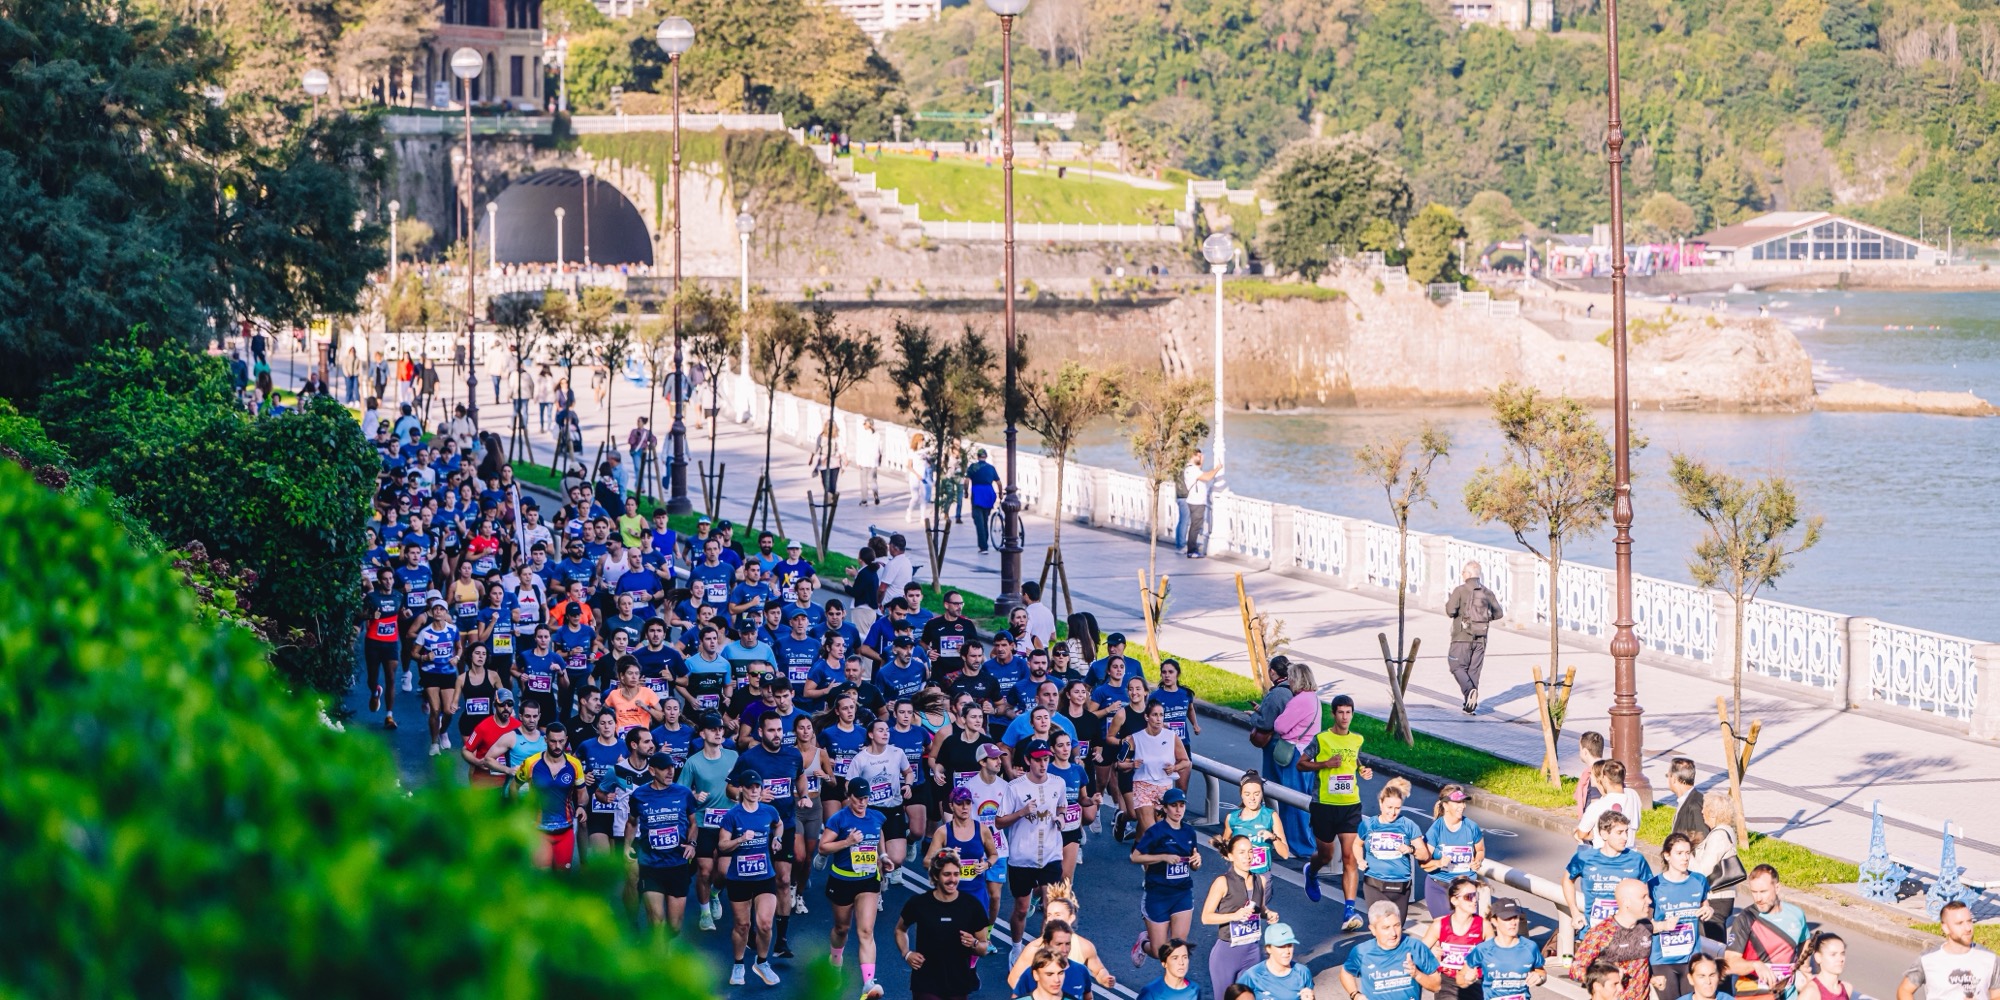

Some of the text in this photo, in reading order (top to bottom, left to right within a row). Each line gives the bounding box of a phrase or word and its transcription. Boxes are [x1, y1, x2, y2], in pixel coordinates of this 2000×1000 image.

[774, 786, 788, 794] 254
[1336, 783, 1352, 791] 388
[709, 815, 724, 824] 14
[654, 835, 678, 846] 1183
[742, 862, 766, 872] 1719
[1171, 864, 1188, 874] 1616
[1234, 923, 1258, 935] 1784
[1663, 932, 1692, 946] 3204
